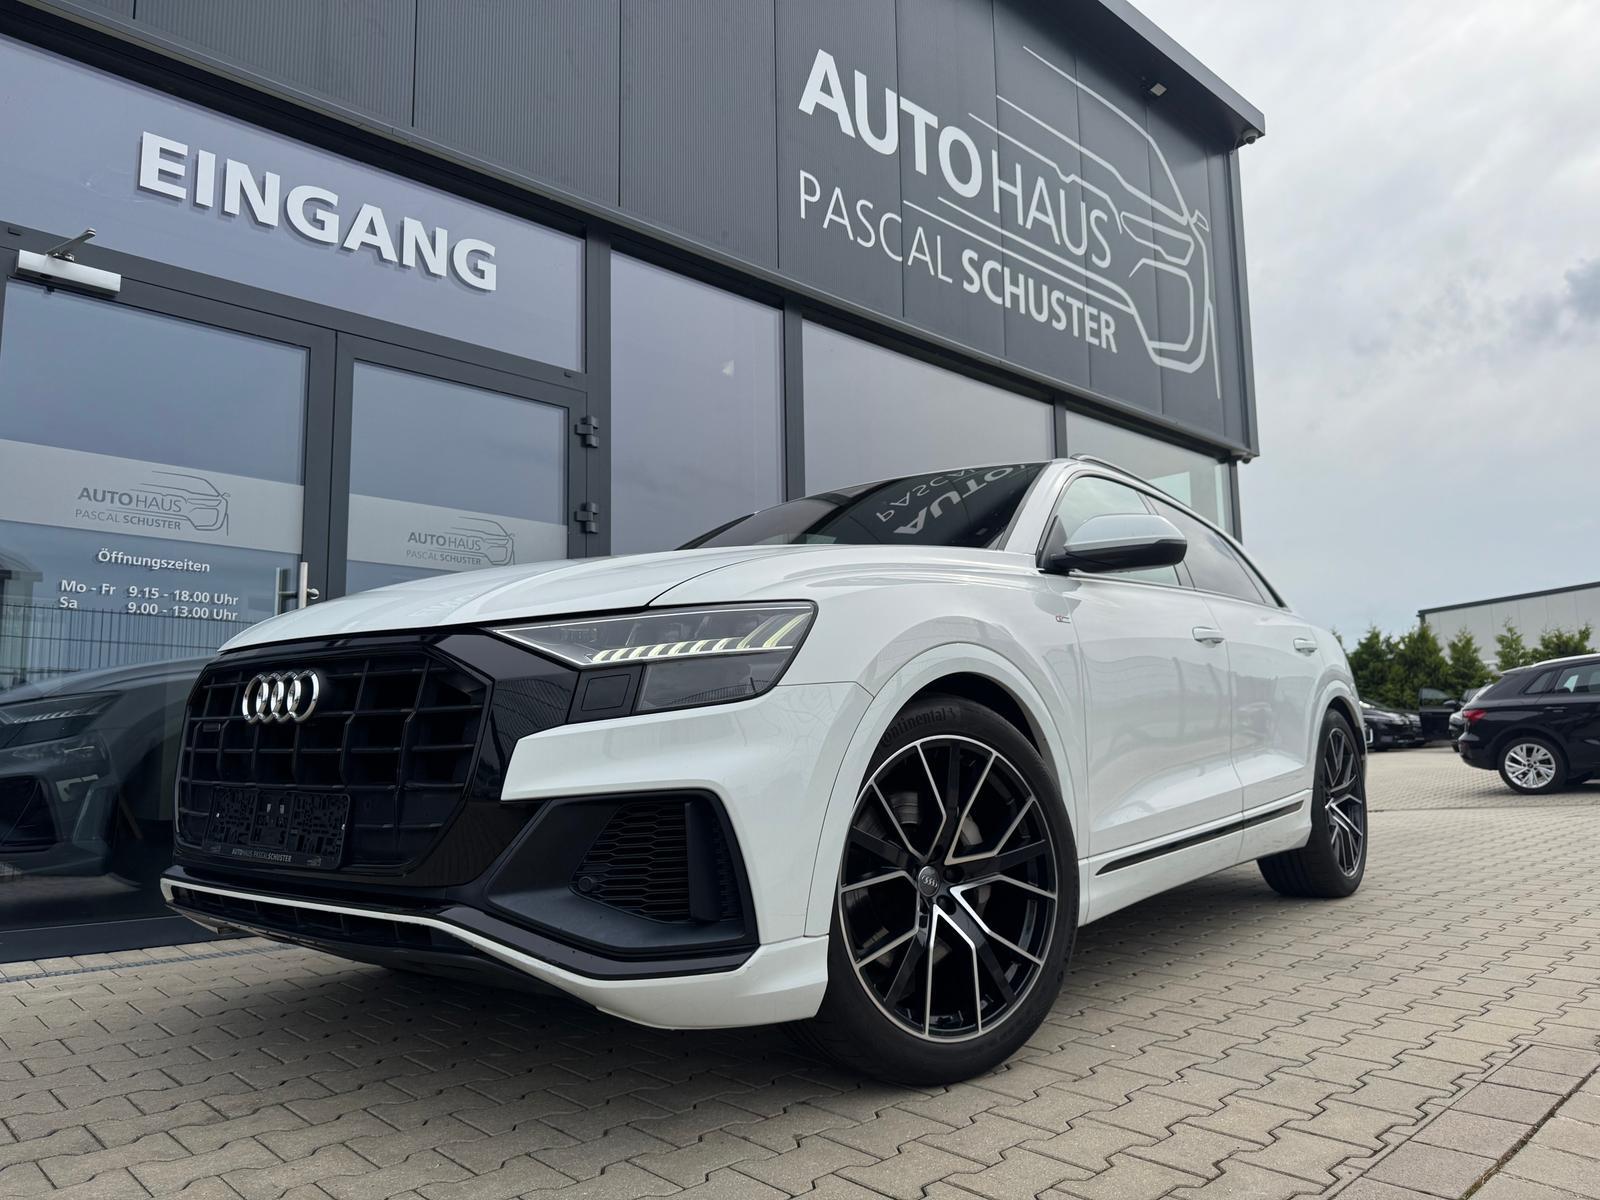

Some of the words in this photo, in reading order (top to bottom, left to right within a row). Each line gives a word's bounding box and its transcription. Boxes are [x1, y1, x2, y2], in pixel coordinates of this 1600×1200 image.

[799, 49, 1112, 269] AUTOHAUS
[139, 131, 497, 292] EINGANG
[799, 170, 953, 283] PASCAL
[961, 249, 1118, 353] SCHUSTER
[77, 487, 182, 513] AUTOHAUS
[75, 509, 121, 523] PASCAL
[123, 514, 182, 531] SCHUSTER
[407, 531, 482, 551] AUTOHAUS
[98, 548, 210, 573] Öffnungszeiten
[406, 549, 437, 561] PASCAL
[439, 552, 482, 566] SCHUSTER
[60, 579, 87, 593] Mo
[102, 583, 116, 595] Fr
[128, 585, 160, 599] 9.15
[174, 589, 210, 603] 18.00
[214, 592, 239, 606] Uhr
[59, 596, 78, 609] Sa
[127, 601, 159, 615] 9.00
[172, 605, 209, 619] 13.00
[213, 608, 238, 621] Uhr
